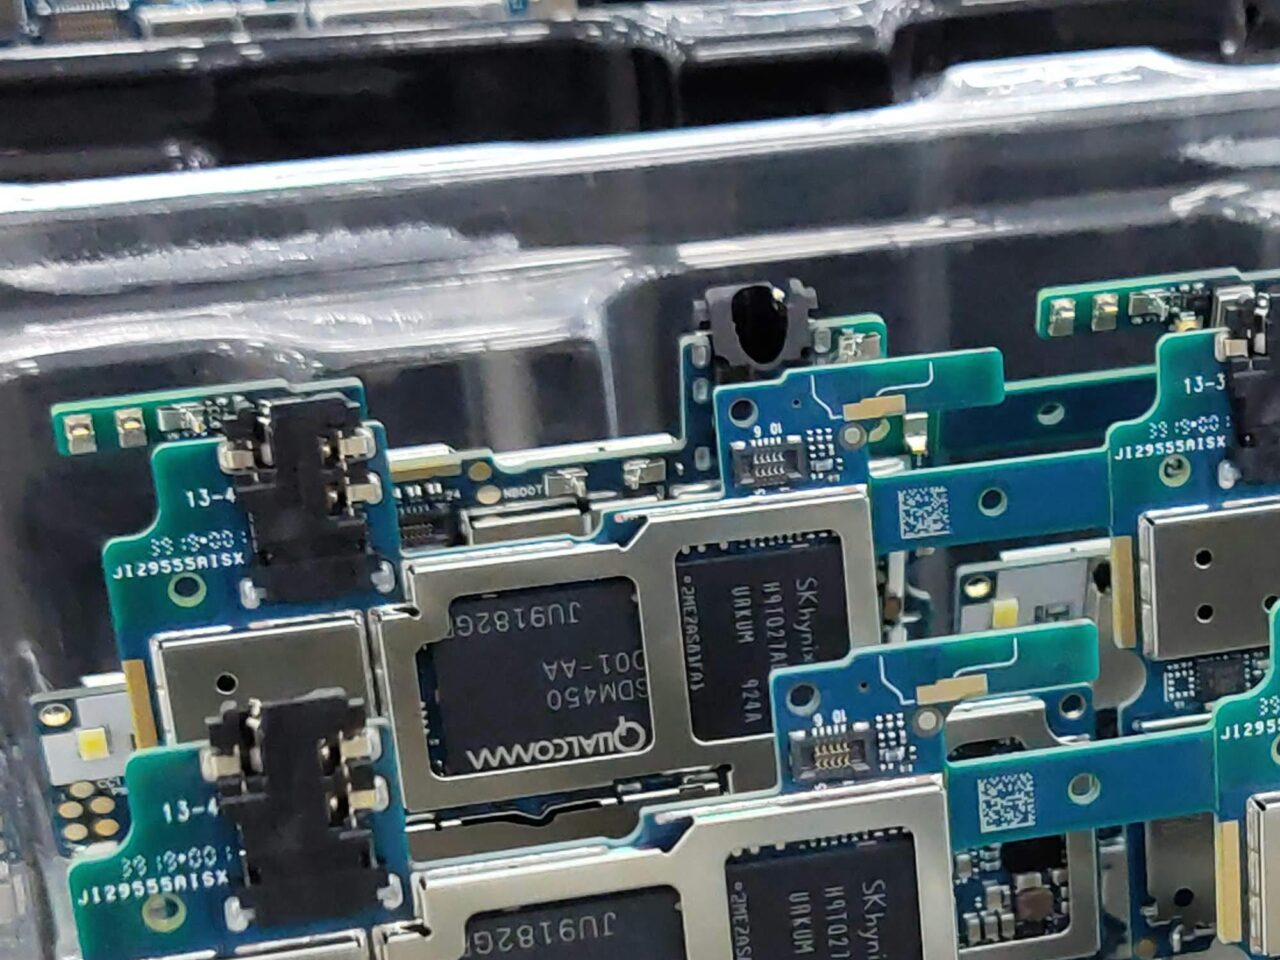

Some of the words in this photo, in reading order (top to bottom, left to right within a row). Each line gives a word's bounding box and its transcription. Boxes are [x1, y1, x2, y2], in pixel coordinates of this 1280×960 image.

[450, 601, 582, 638] JU9182G
[465, 715, 646, 770] QUALCOMM
[466, 912, 617, 957] JU9182G
